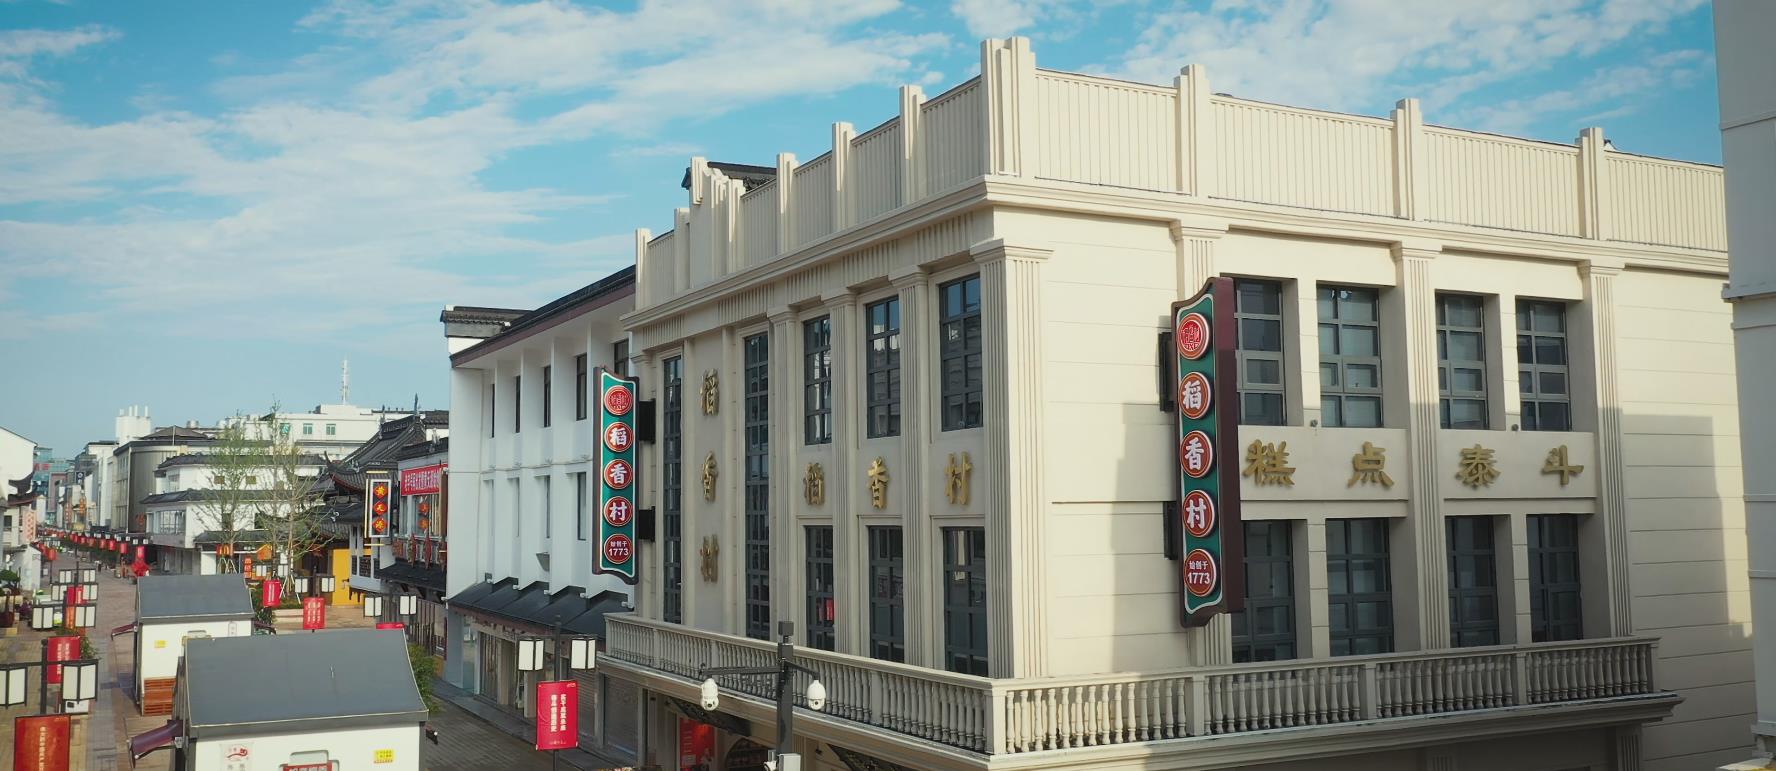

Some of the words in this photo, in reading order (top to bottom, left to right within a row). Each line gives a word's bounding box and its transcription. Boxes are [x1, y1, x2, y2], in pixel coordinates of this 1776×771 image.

[608, 426, 628, 521] 稻香村
[698, 367, 720, 584] 稻香村
[803, 451, 973, 509] 稻香村
[1182, 379, 1207, 530] 稻香村
[1242, 438, 1585, 489] 糕点泰斗
[608, 548, 629, 556] 1773
[1187, 571, 1211, 585] 1773
[1188, 560, 1209, 570] 始创于
